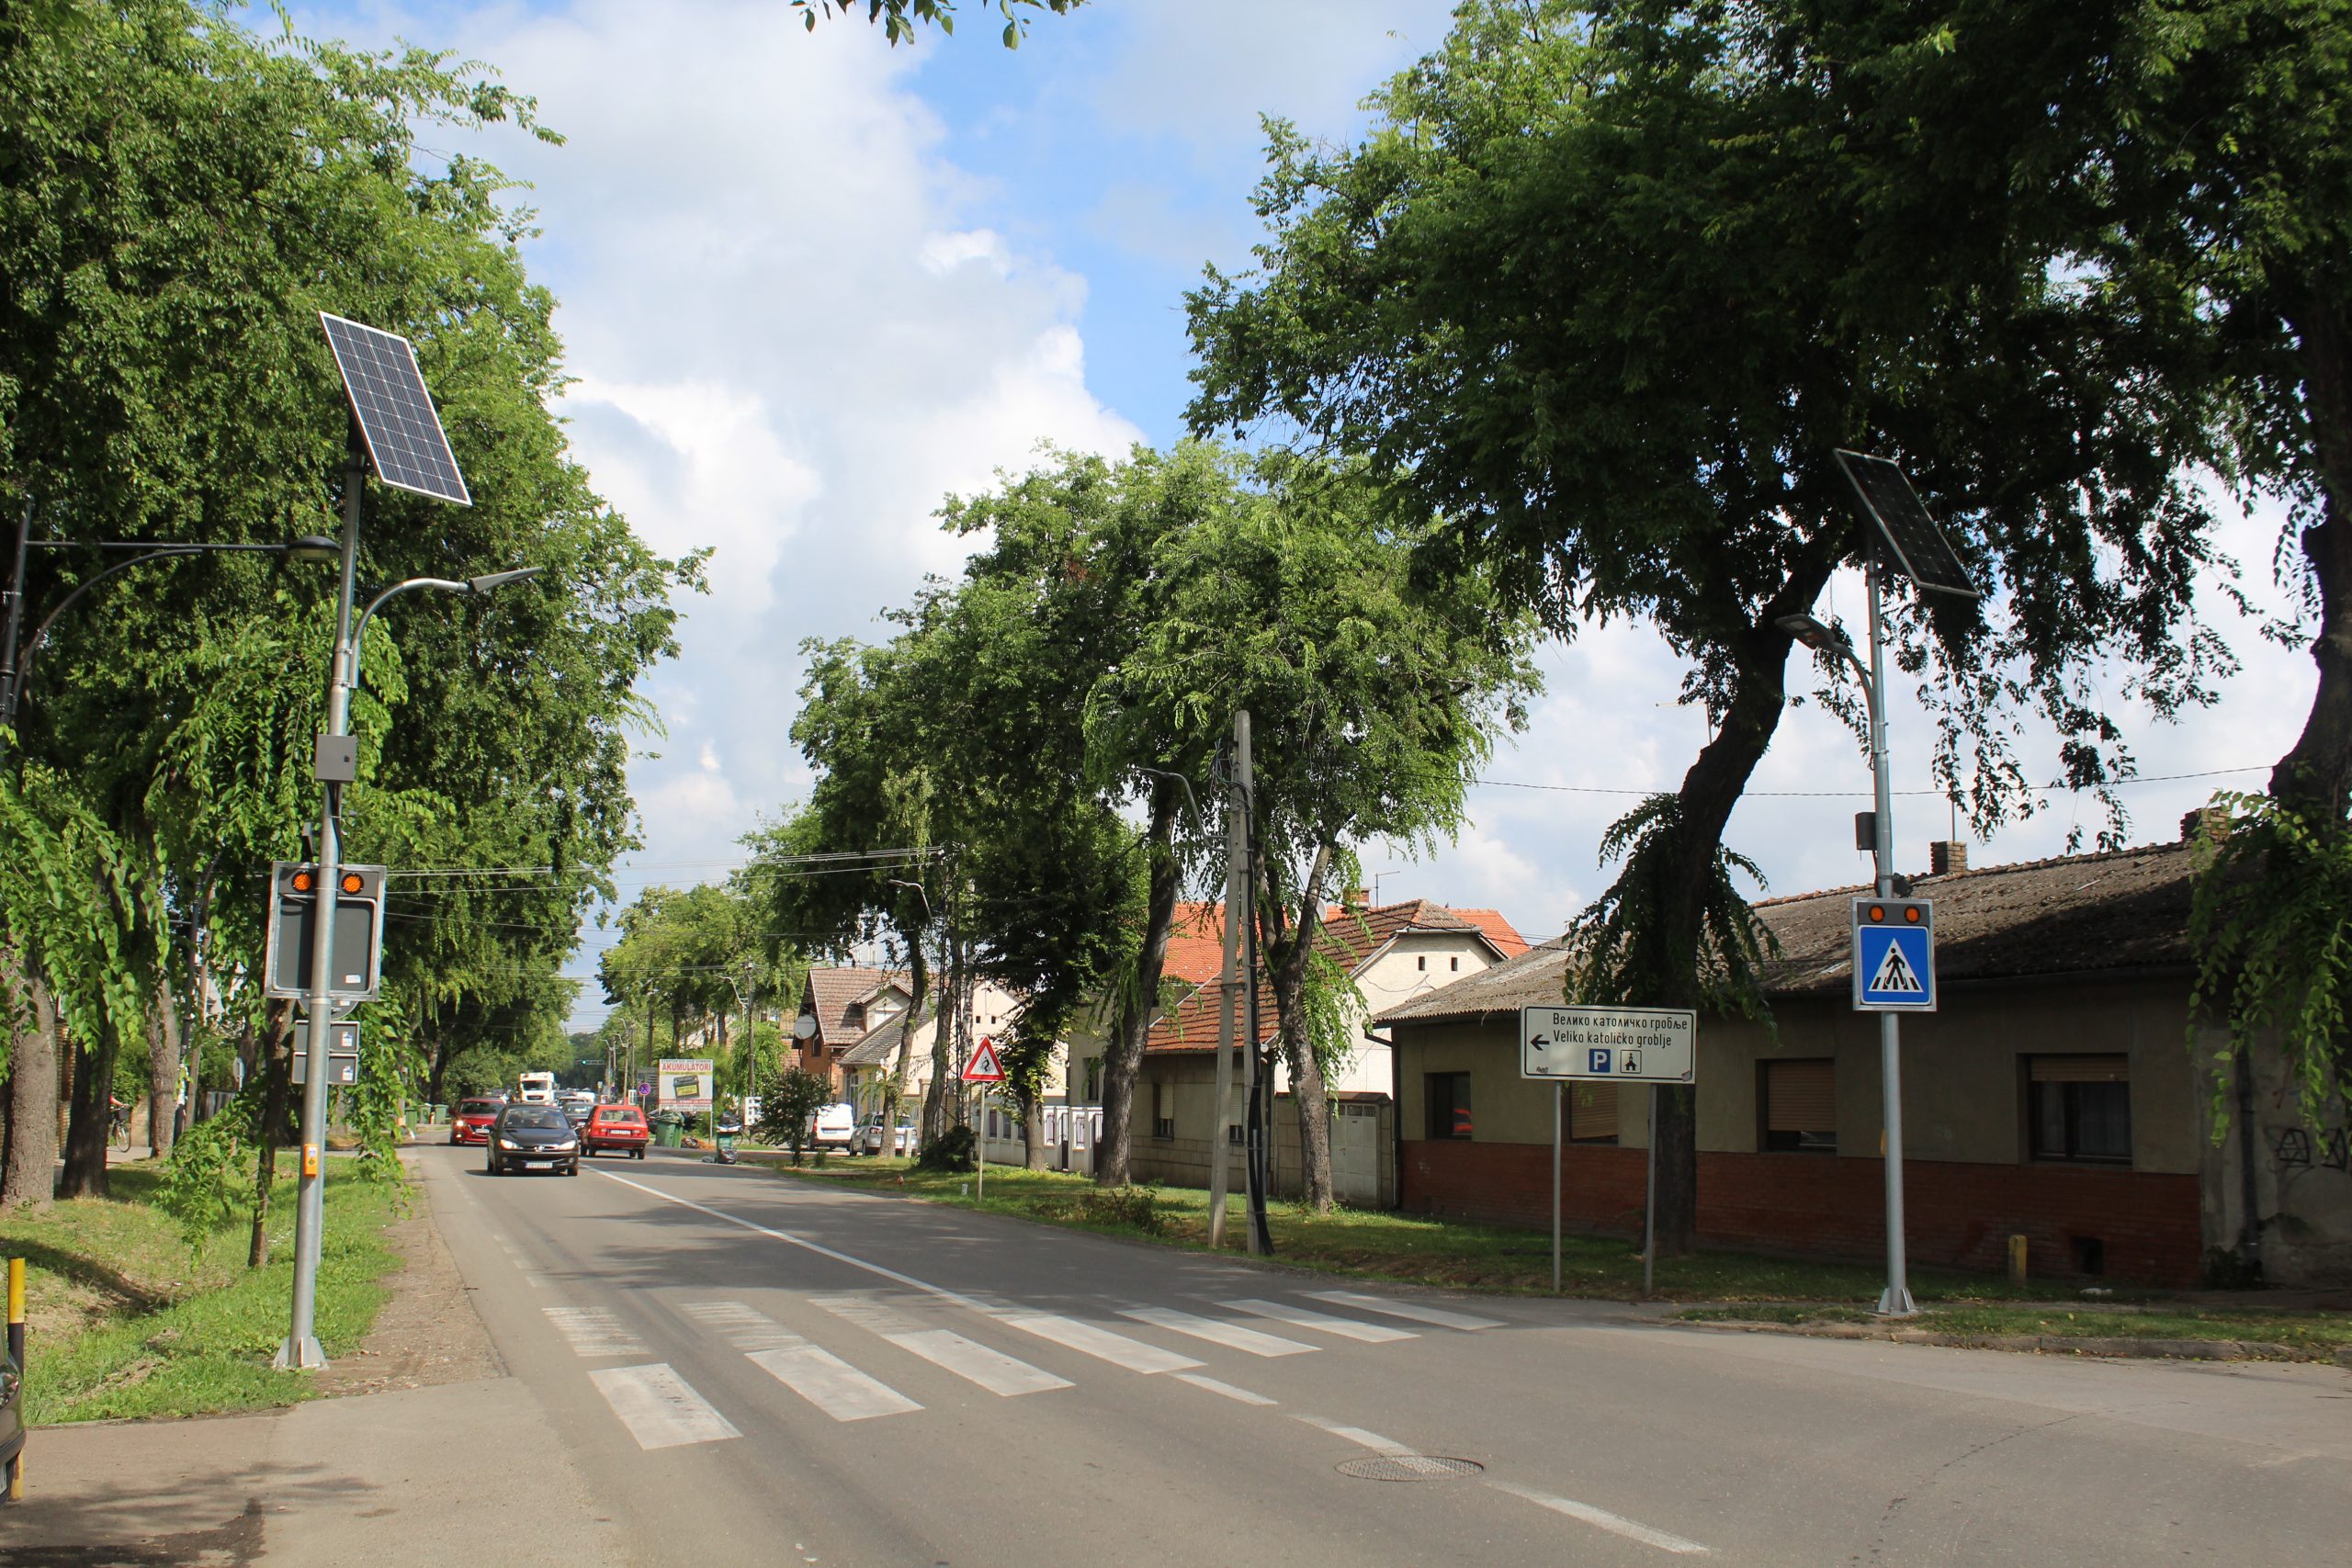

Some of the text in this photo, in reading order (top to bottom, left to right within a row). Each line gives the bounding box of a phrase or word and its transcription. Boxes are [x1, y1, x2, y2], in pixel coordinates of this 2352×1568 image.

[1553, 1012, 1688, 1032] Велико католичко гробље
[1553, 1030, 1672, 1049] Veliko katoličko groblje
[662, 1063, 711, 1071] AKUMULATORI
[1593, 1051, 1608, 1070] P
